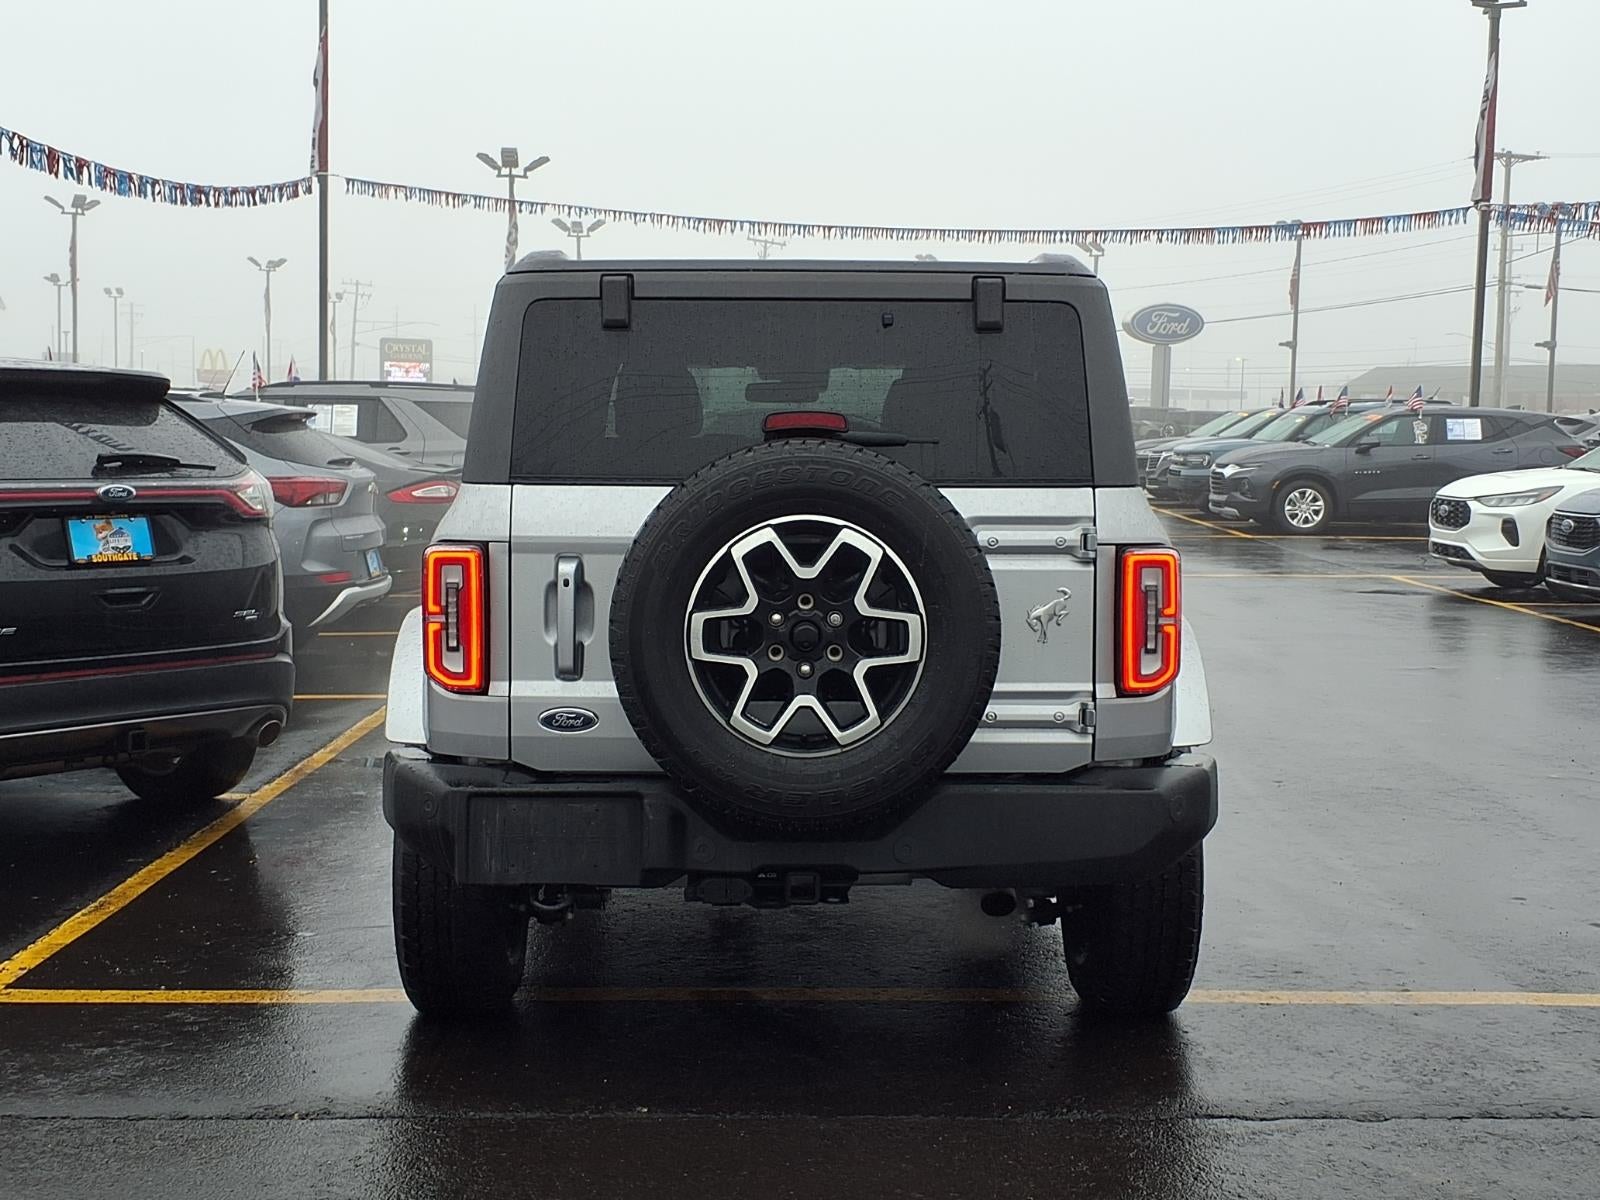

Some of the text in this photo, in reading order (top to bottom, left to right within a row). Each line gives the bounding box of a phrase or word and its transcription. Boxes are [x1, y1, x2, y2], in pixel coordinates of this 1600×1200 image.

[1147, 311, 1191, 335] Ford
[92, 552, 139, 563] SOUTHGATE
[552, 712, 585, 727] Ford
